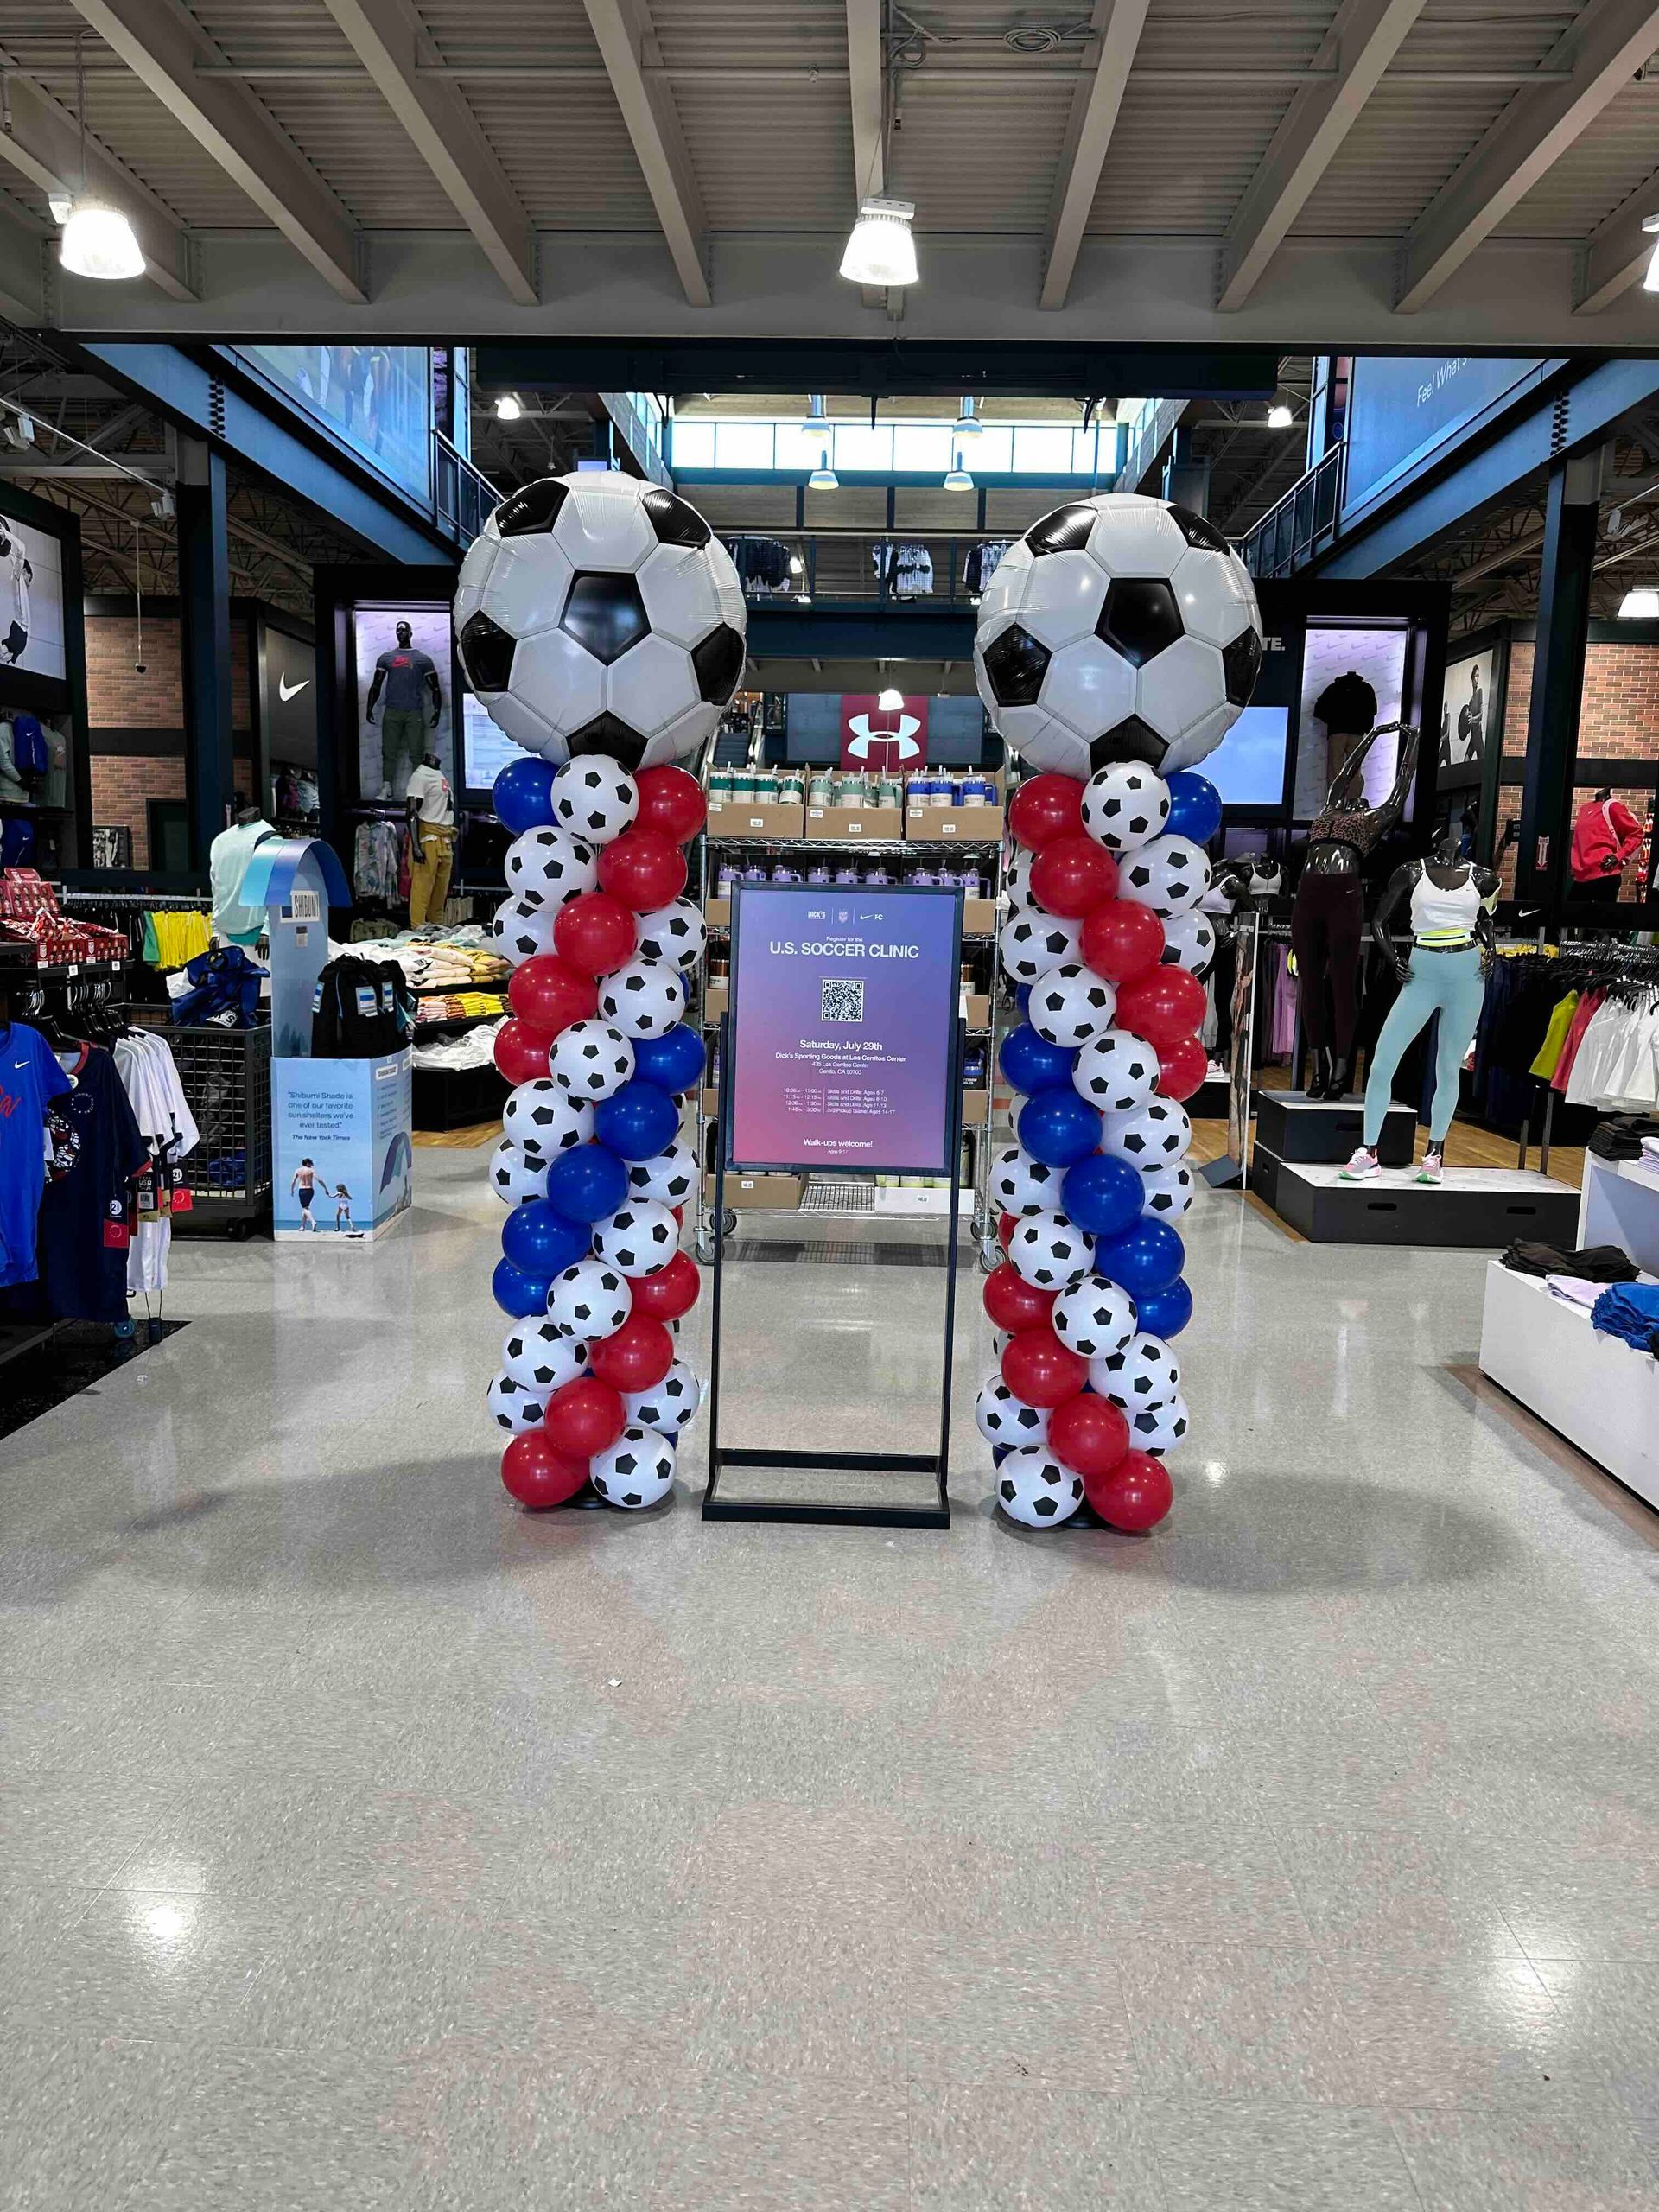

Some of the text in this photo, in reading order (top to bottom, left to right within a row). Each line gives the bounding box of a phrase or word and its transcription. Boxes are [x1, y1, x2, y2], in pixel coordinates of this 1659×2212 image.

[1417, 373, 1435, 408] Feel
[769, 941, 919, 958] U.S. SOCCER CLINIC
[799, 1039, 883, 1052] Saturday, July 29th
[804, 1138, 873, 1148] Walk-ups welcome!
